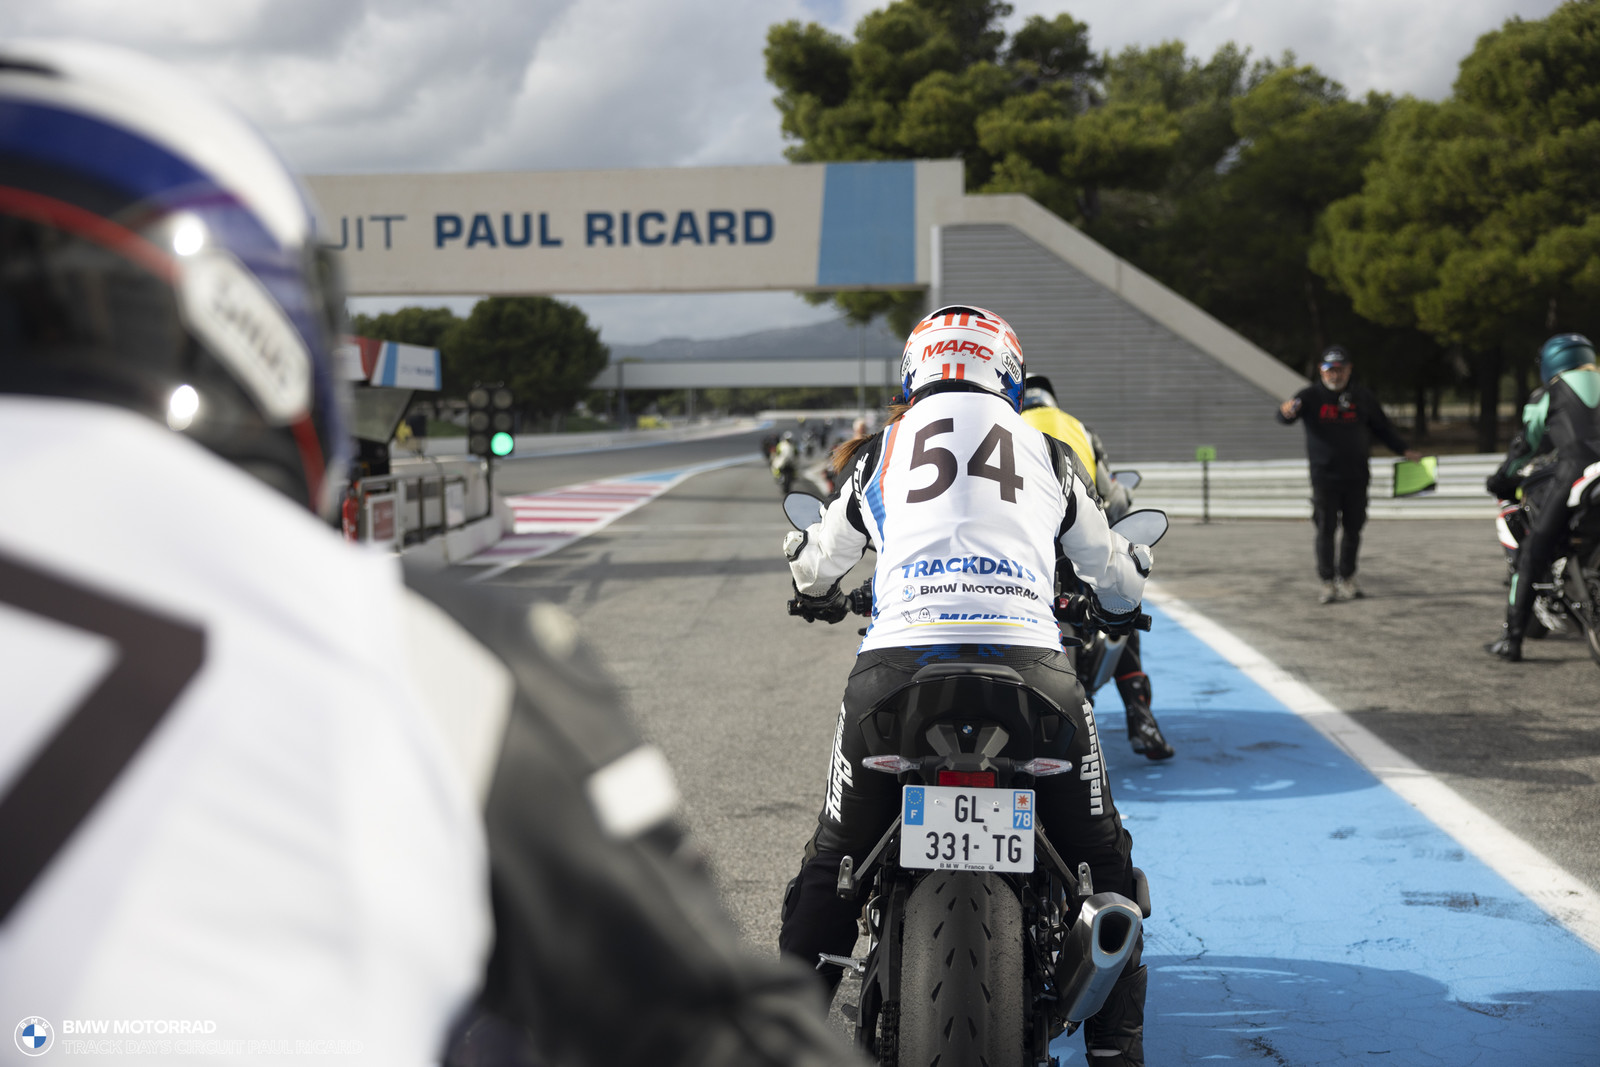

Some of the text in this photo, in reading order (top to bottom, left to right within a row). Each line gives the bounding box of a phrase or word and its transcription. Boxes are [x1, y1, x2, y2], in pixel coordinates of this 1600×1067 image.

[434, 212, 562, 249] PAUL
[584, 209, 775, 247] RICARD
[921, 339, 994, 361] MARC
[1005, 355, 1022, 381] SHOEI
[905, 416, 1024, 505] 54
[901, 556, 1036, 582] TRACKDAYS
[920, 583, 957, 595] BMW
[910, 809, 918, 819] F
[1014, 812, 1031, 828] 78
[992, 834, 1022, 863] TG
